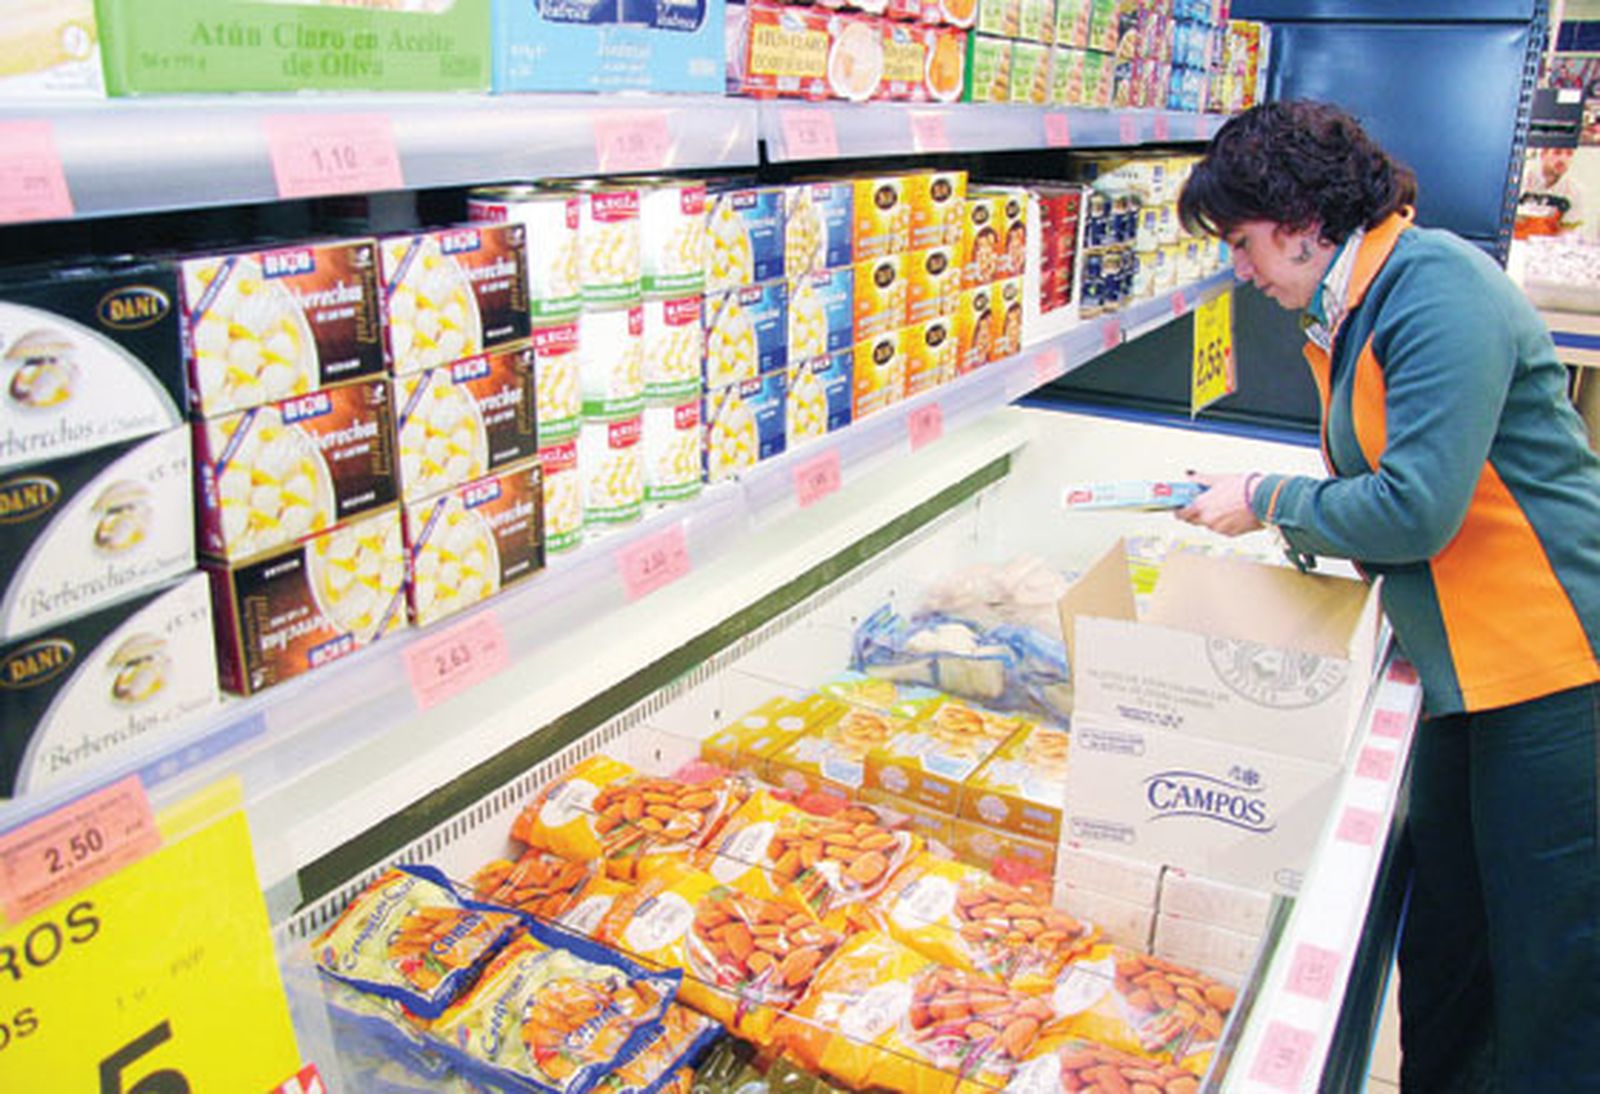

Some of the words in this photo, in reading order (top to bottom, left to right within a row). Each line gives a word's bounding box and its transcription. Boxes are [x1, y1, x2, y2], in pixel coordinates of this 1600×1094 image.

[190, 22, 262, 48] Atún
[273, 22, 346, 51] Claro
[281, 53, 313, 77] de
[319, 53, 383, 77] Oliva
[110, 296, 158, 321] DANI
[0, 484, 48, 514] DANI
[9, 645, 64, 681] DANI
[1147, 779, 1266, 826] CAMPOS
